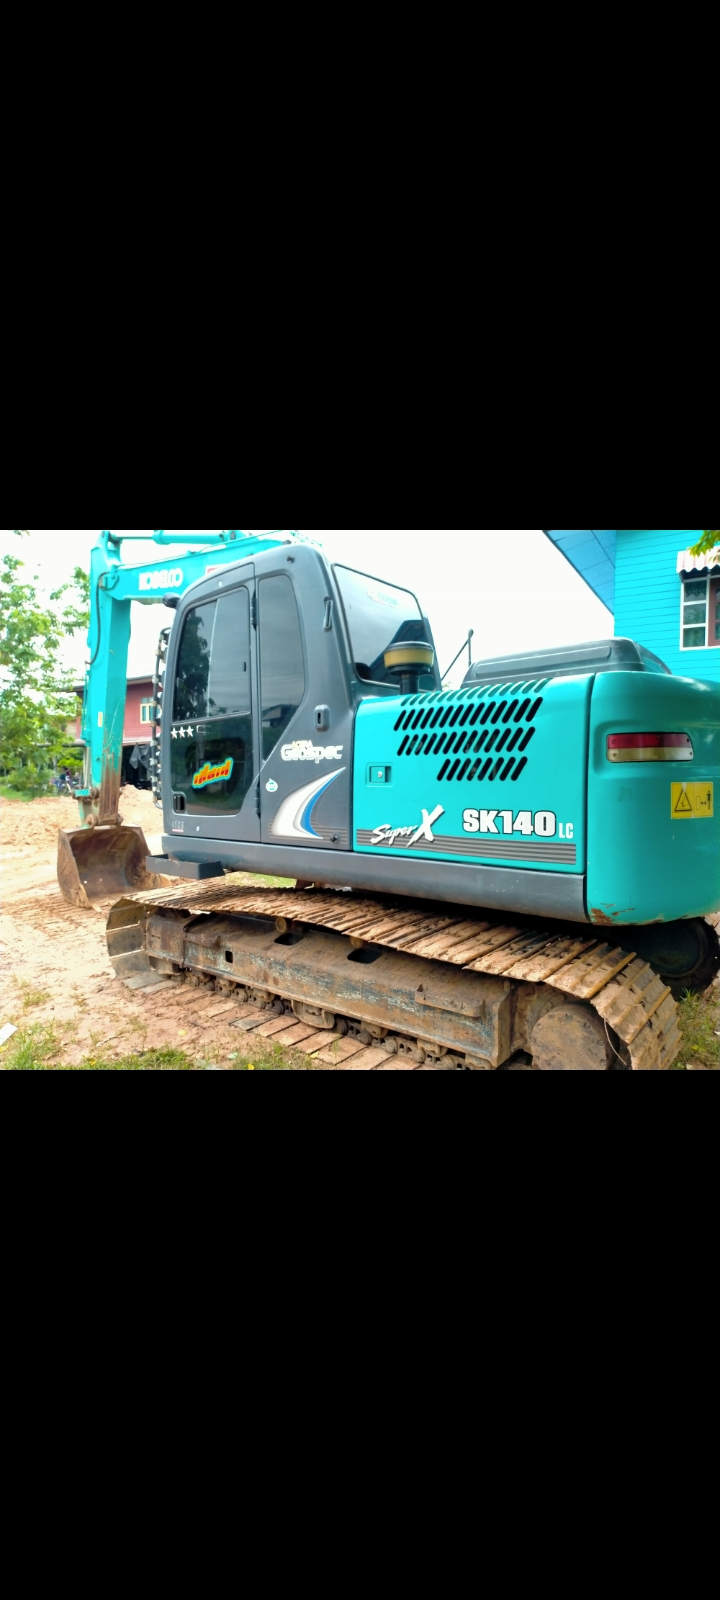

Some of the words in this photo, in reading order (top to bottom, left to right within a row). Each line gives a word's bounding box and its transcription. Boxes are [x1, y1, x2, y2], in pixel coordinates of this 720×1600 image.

[139, 568, 183, 591] KOBELCO
[370, 823, 418, 847] Super
[406, 804, 445, 847] X
[462, 808, 556, 837] SK140
[558, 823, 574, 839] LC
